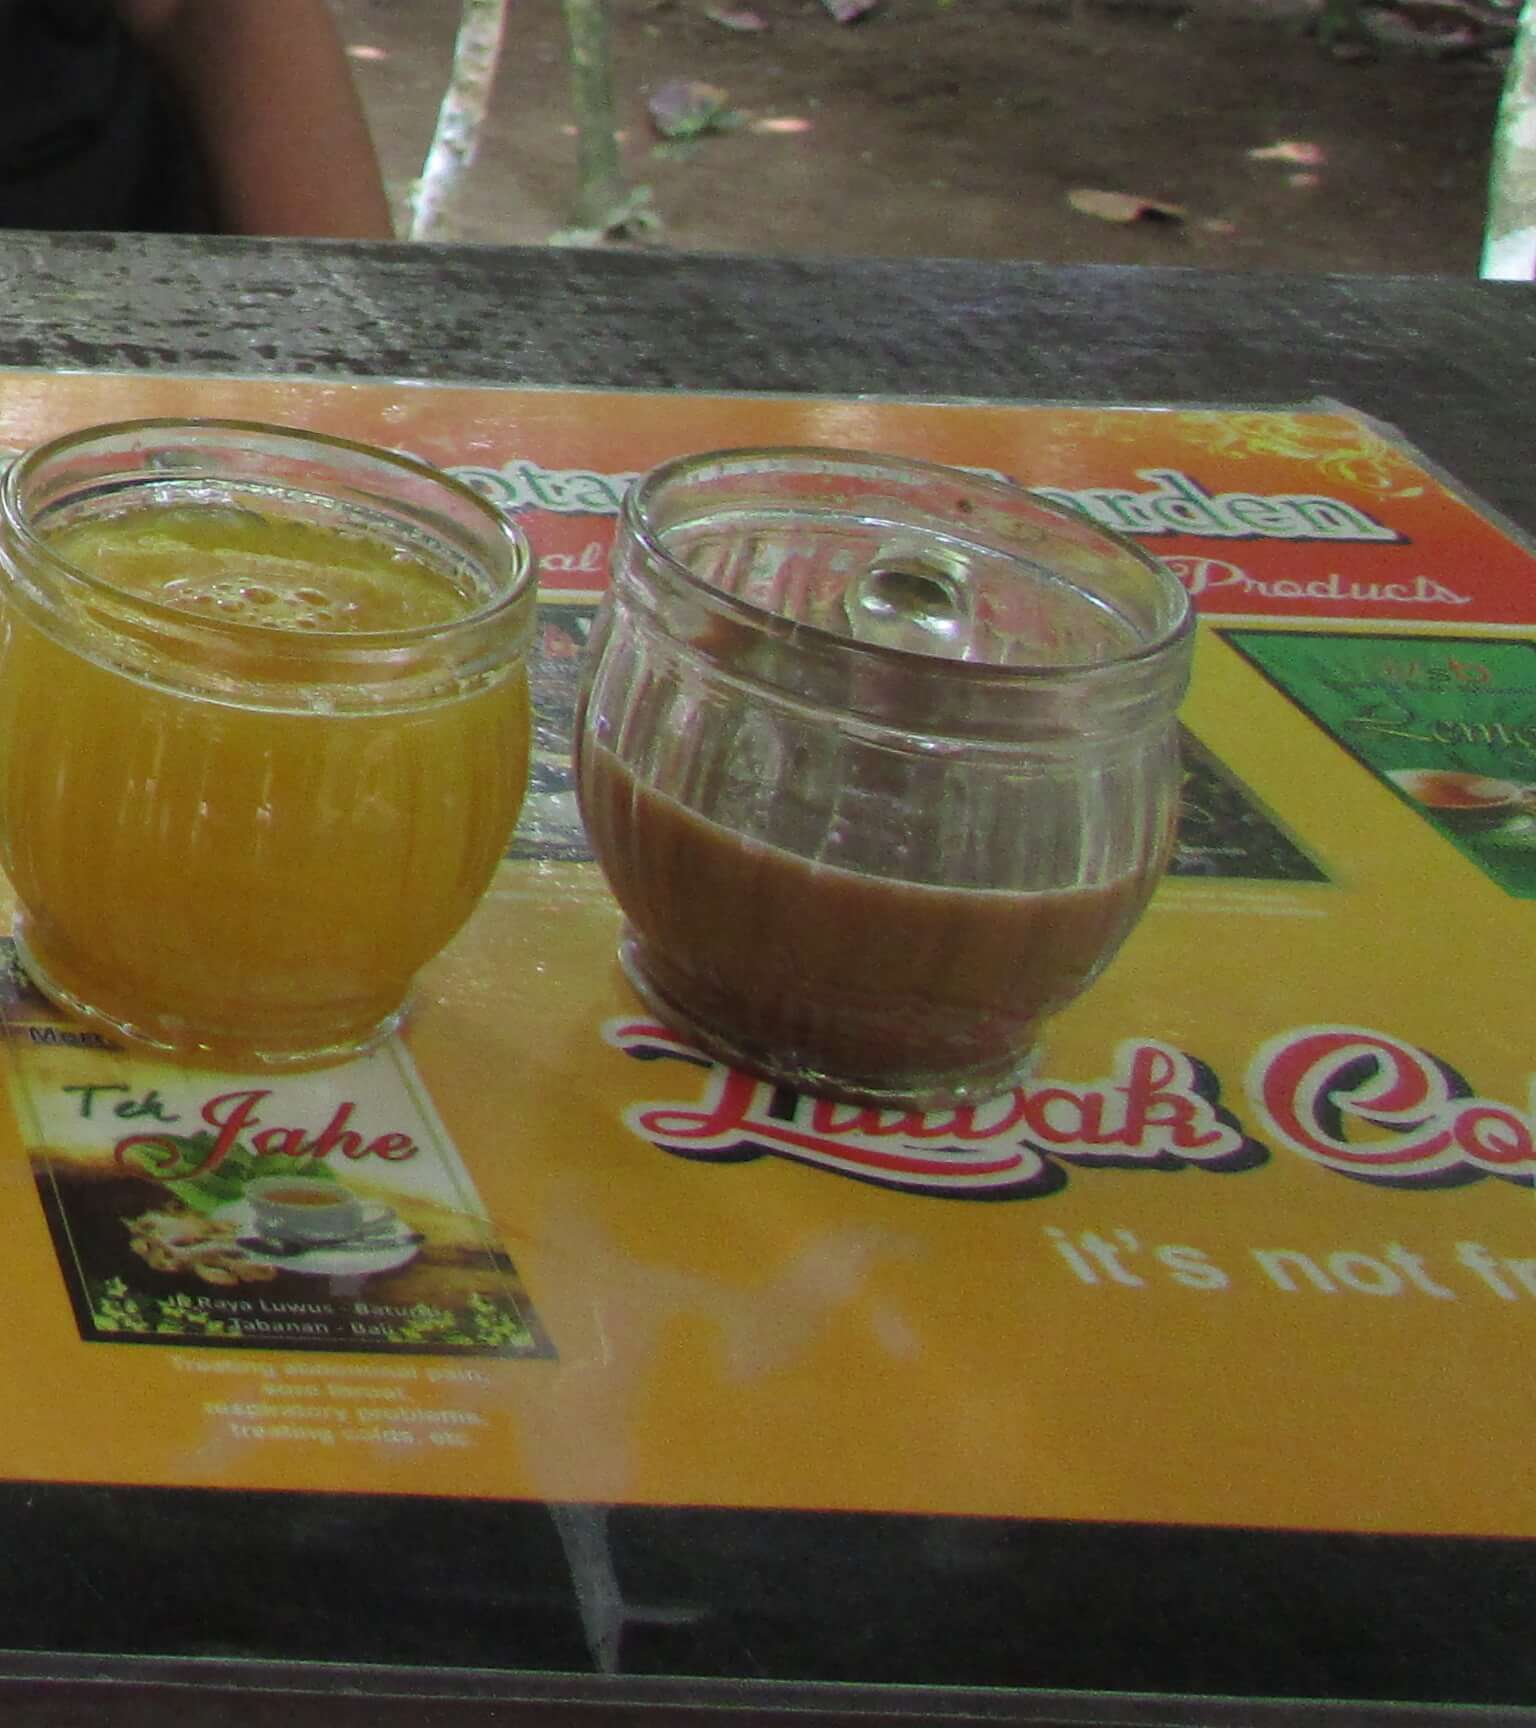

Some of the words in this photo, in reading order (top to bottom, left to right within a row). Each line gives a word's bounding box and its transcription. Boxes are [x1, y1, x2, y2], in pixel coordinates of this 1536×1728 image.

[1031, 468, 1400, 542] arden
[1163, 555, 1473, 607] Products
[114, 1089, 420, 1181] Jahe
[1042, 1223, 1230, 1292] it's
[1251, 1240, 1457, 1302] not
